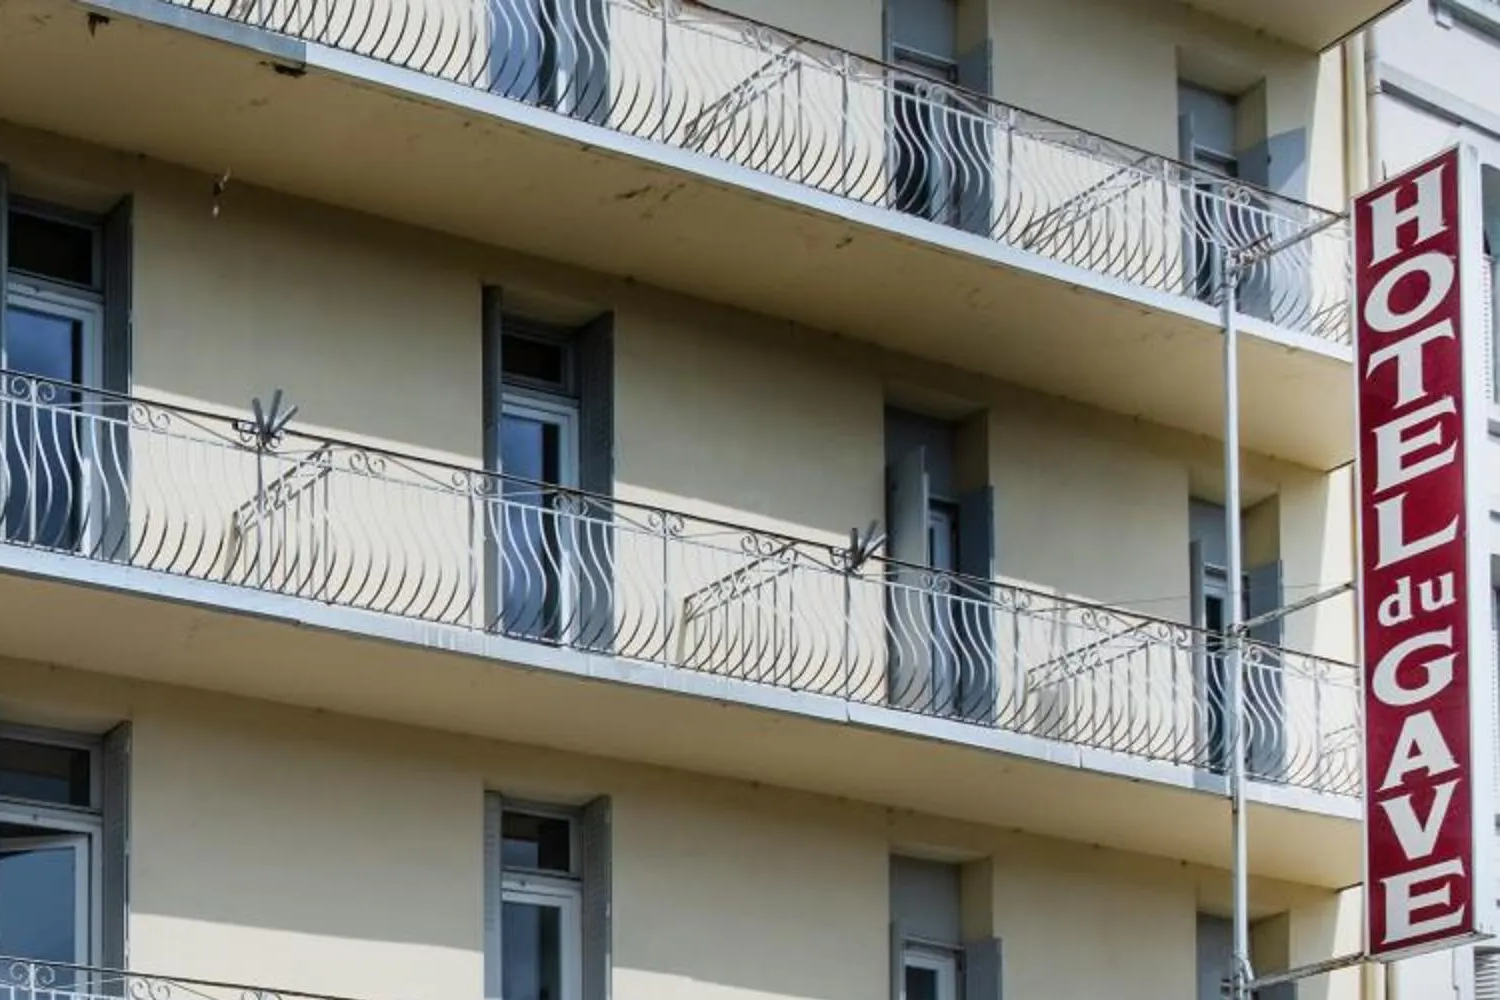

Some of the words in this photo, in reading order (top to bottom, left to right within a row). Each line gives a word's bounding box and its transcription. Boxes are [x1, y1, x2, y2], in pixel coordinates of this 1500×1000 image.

[1364, 162, 1459, 571] HOTEL
[1377, 571, 1455, 628] du
[1371, 625, 1464, 945] GAVE
